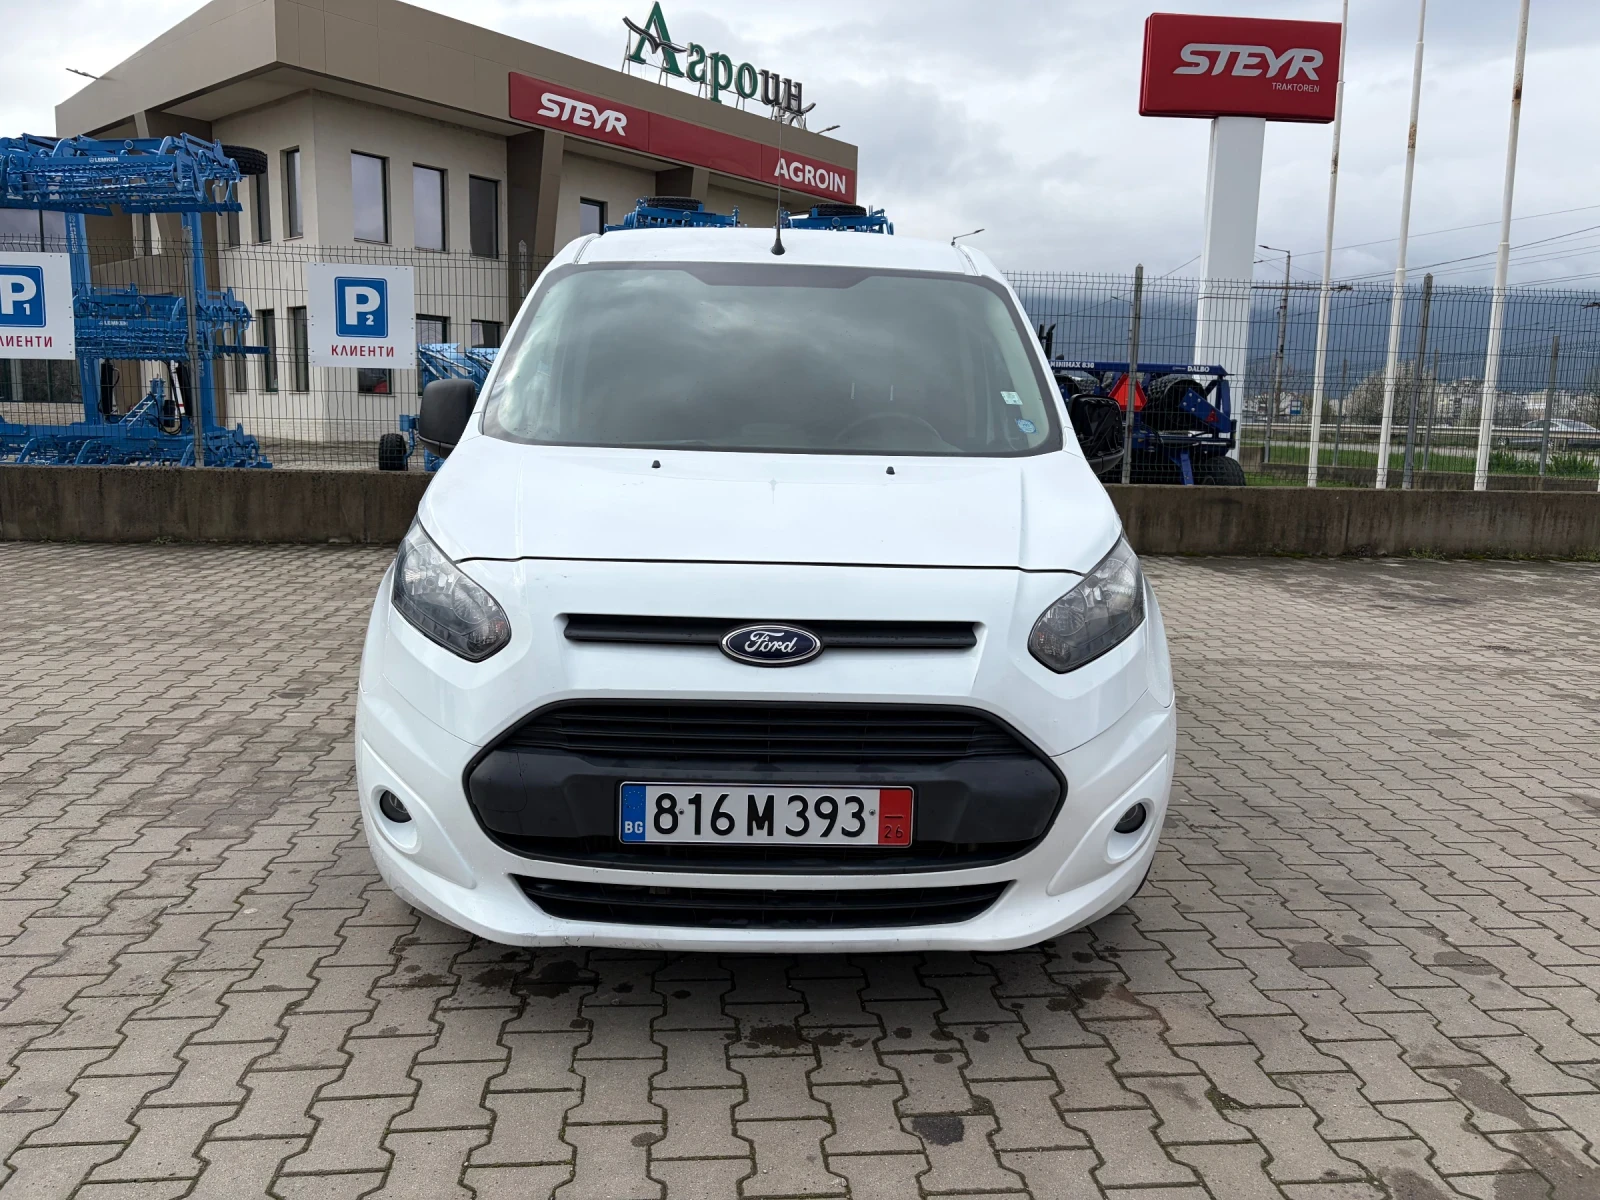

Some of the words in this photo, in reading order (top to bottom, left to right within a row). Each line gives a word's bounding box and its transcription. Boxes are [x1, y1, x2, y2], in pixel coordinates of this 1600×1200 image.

[1173, 43, 1324, 80] STEYR
[1271, 82, 1320, 92] TRAKTOREN
[537, 92, 627, 136] STEYR
[774, 157, 846, 194] AGROIN
[331, 344, 395, 357] КЛИЕНТИ
[1187, 365, 1210, 373] DALBO
[744, 630, 798, 653] Ford
[624, 821, 643, 834] BG
[883, 825, 904, 839] 26
